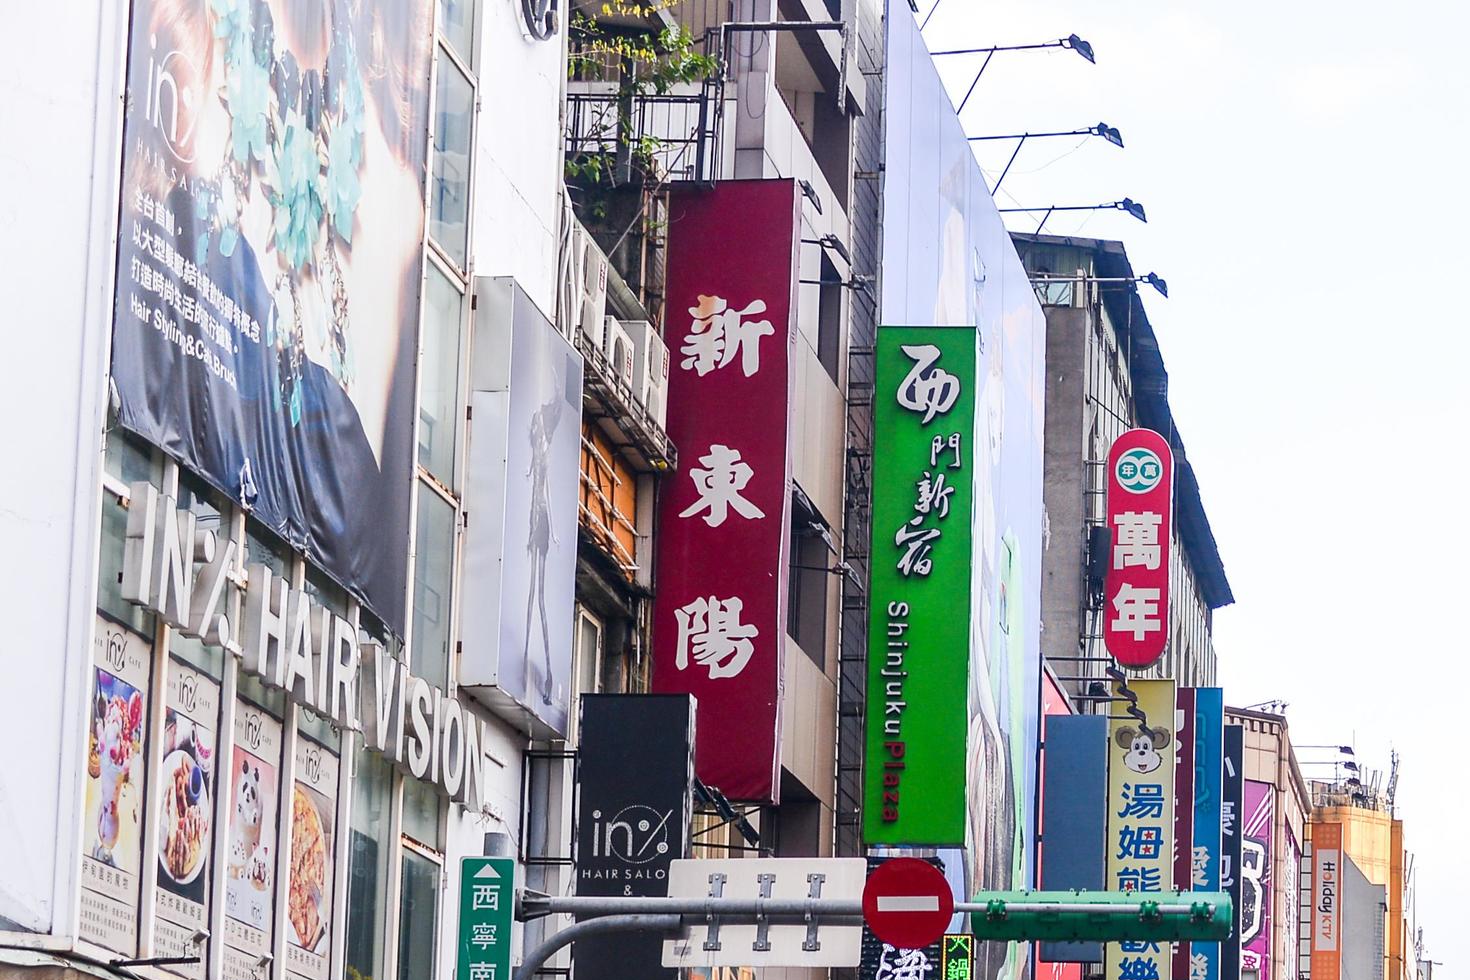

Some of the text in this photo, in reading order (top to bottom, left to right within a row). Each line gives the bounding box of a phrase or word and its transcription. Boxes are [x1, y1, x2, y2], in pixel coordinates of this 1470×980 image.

[131, 293, 152, 324] Hair
[674, 293, 776, 680] 新東陽
[894, 343, 963, 579] 西門新宿
[241, 563, 360, 731] HAIR
[1110, 510, 1164, 643] 萬年
[361, 642, 487, 808] VISION
[879, 599, 912, 826] Shinjuku Plaza
[582, 869, 667, 880] HAIR SALO
[623, 884, 633, 896] &
[1317, 862, 1336, 940] Holiday KTV
